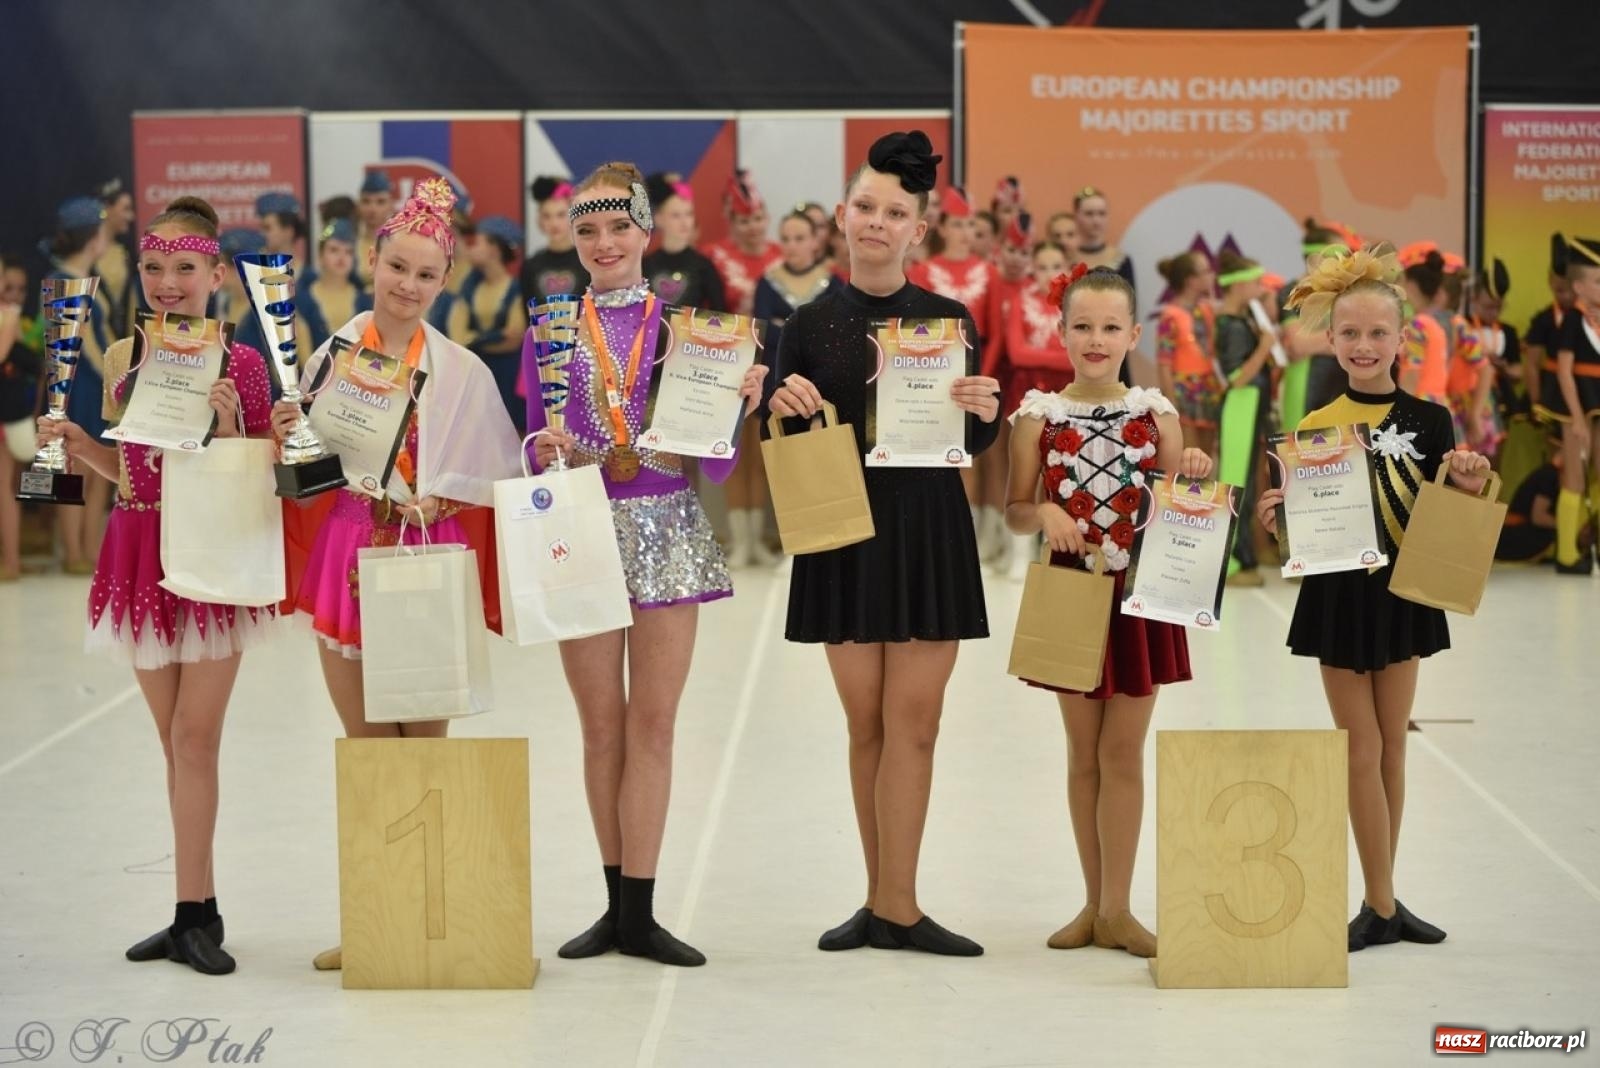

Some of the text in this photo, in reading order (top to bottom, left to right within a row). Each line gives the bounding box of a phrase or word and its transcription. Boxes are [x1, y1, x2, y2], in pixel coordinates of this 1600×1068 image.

[1031, 75, 1401, 101] EUROPEAN CHAMPIONSHIP
[1080, 108, 1351, 135] MAJORETTES SPORT
[166, 161, 272, 181] EUROPEAN
[157, 349, 206, 369] DIPLOMA
[683, 342, 738, 363] DIPLOMA
[893, 356, 950, 369] DIPLOMA
[337, 380, 390, 411] DIPLOMA
[906, 382, 934, 390] 4.place
[1296, 462, 1352, 480] DIPLOMA
[1313, 490, 1340, 499] 6.place
[1163, 509, 1215, 531] DIPLOMA
[1171, 537, 1196, 549] 5.place
[384, 788, 447, 940] 1
[1204, 780, 1306, 939] 3
